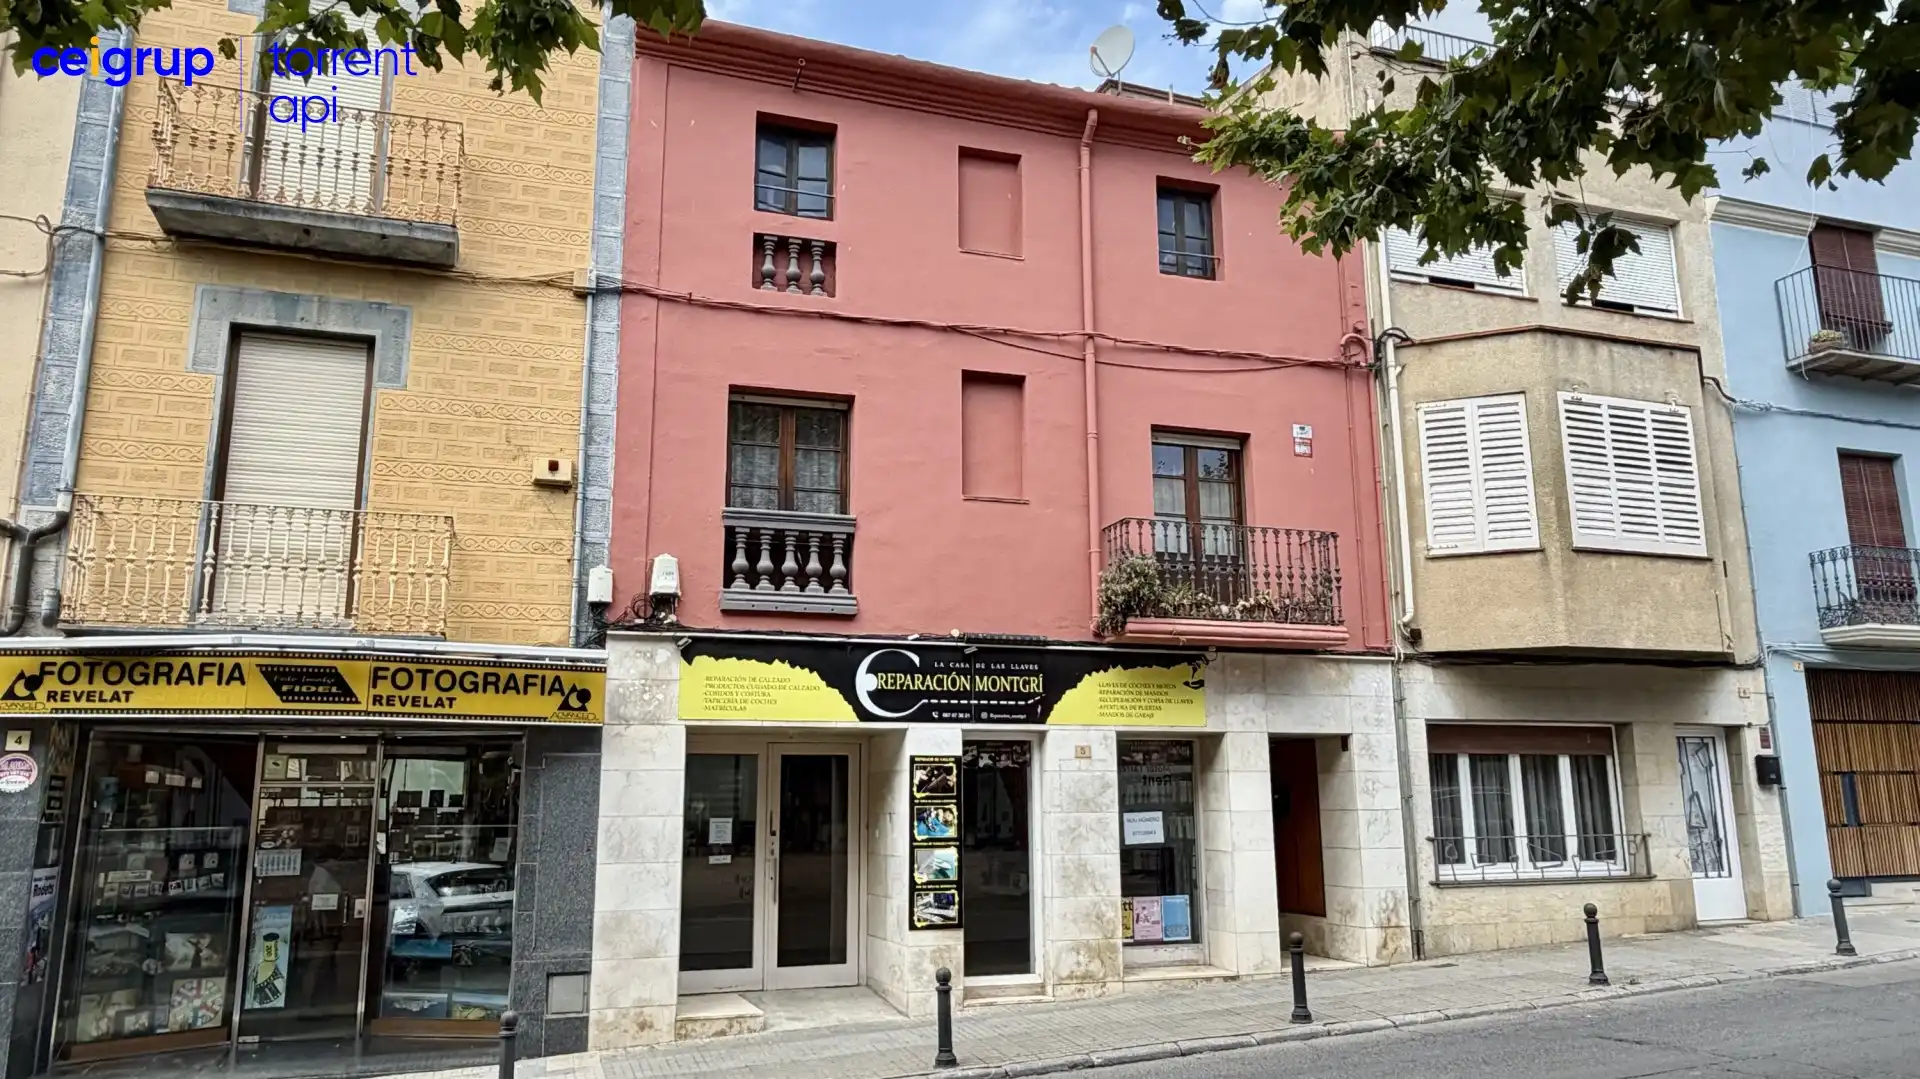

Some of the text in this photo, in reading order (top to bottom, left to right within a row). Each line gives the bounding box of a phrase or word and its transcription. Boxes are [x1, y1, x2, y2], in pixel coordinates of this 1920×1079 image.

[39, 661, 246, 686] FOTOGRAFIA
[372, 666, 565, 696] FOTOGRAFIA
[877, 672, 1043, 692] REPARACIÓN MONTGRÍ
[281, 684, 342, 693] FIDEL
[46, 690, 134, 703] REVELAT
[372, 694, 456, 708] REVELAT
[14, 736, 22, 745] 4
